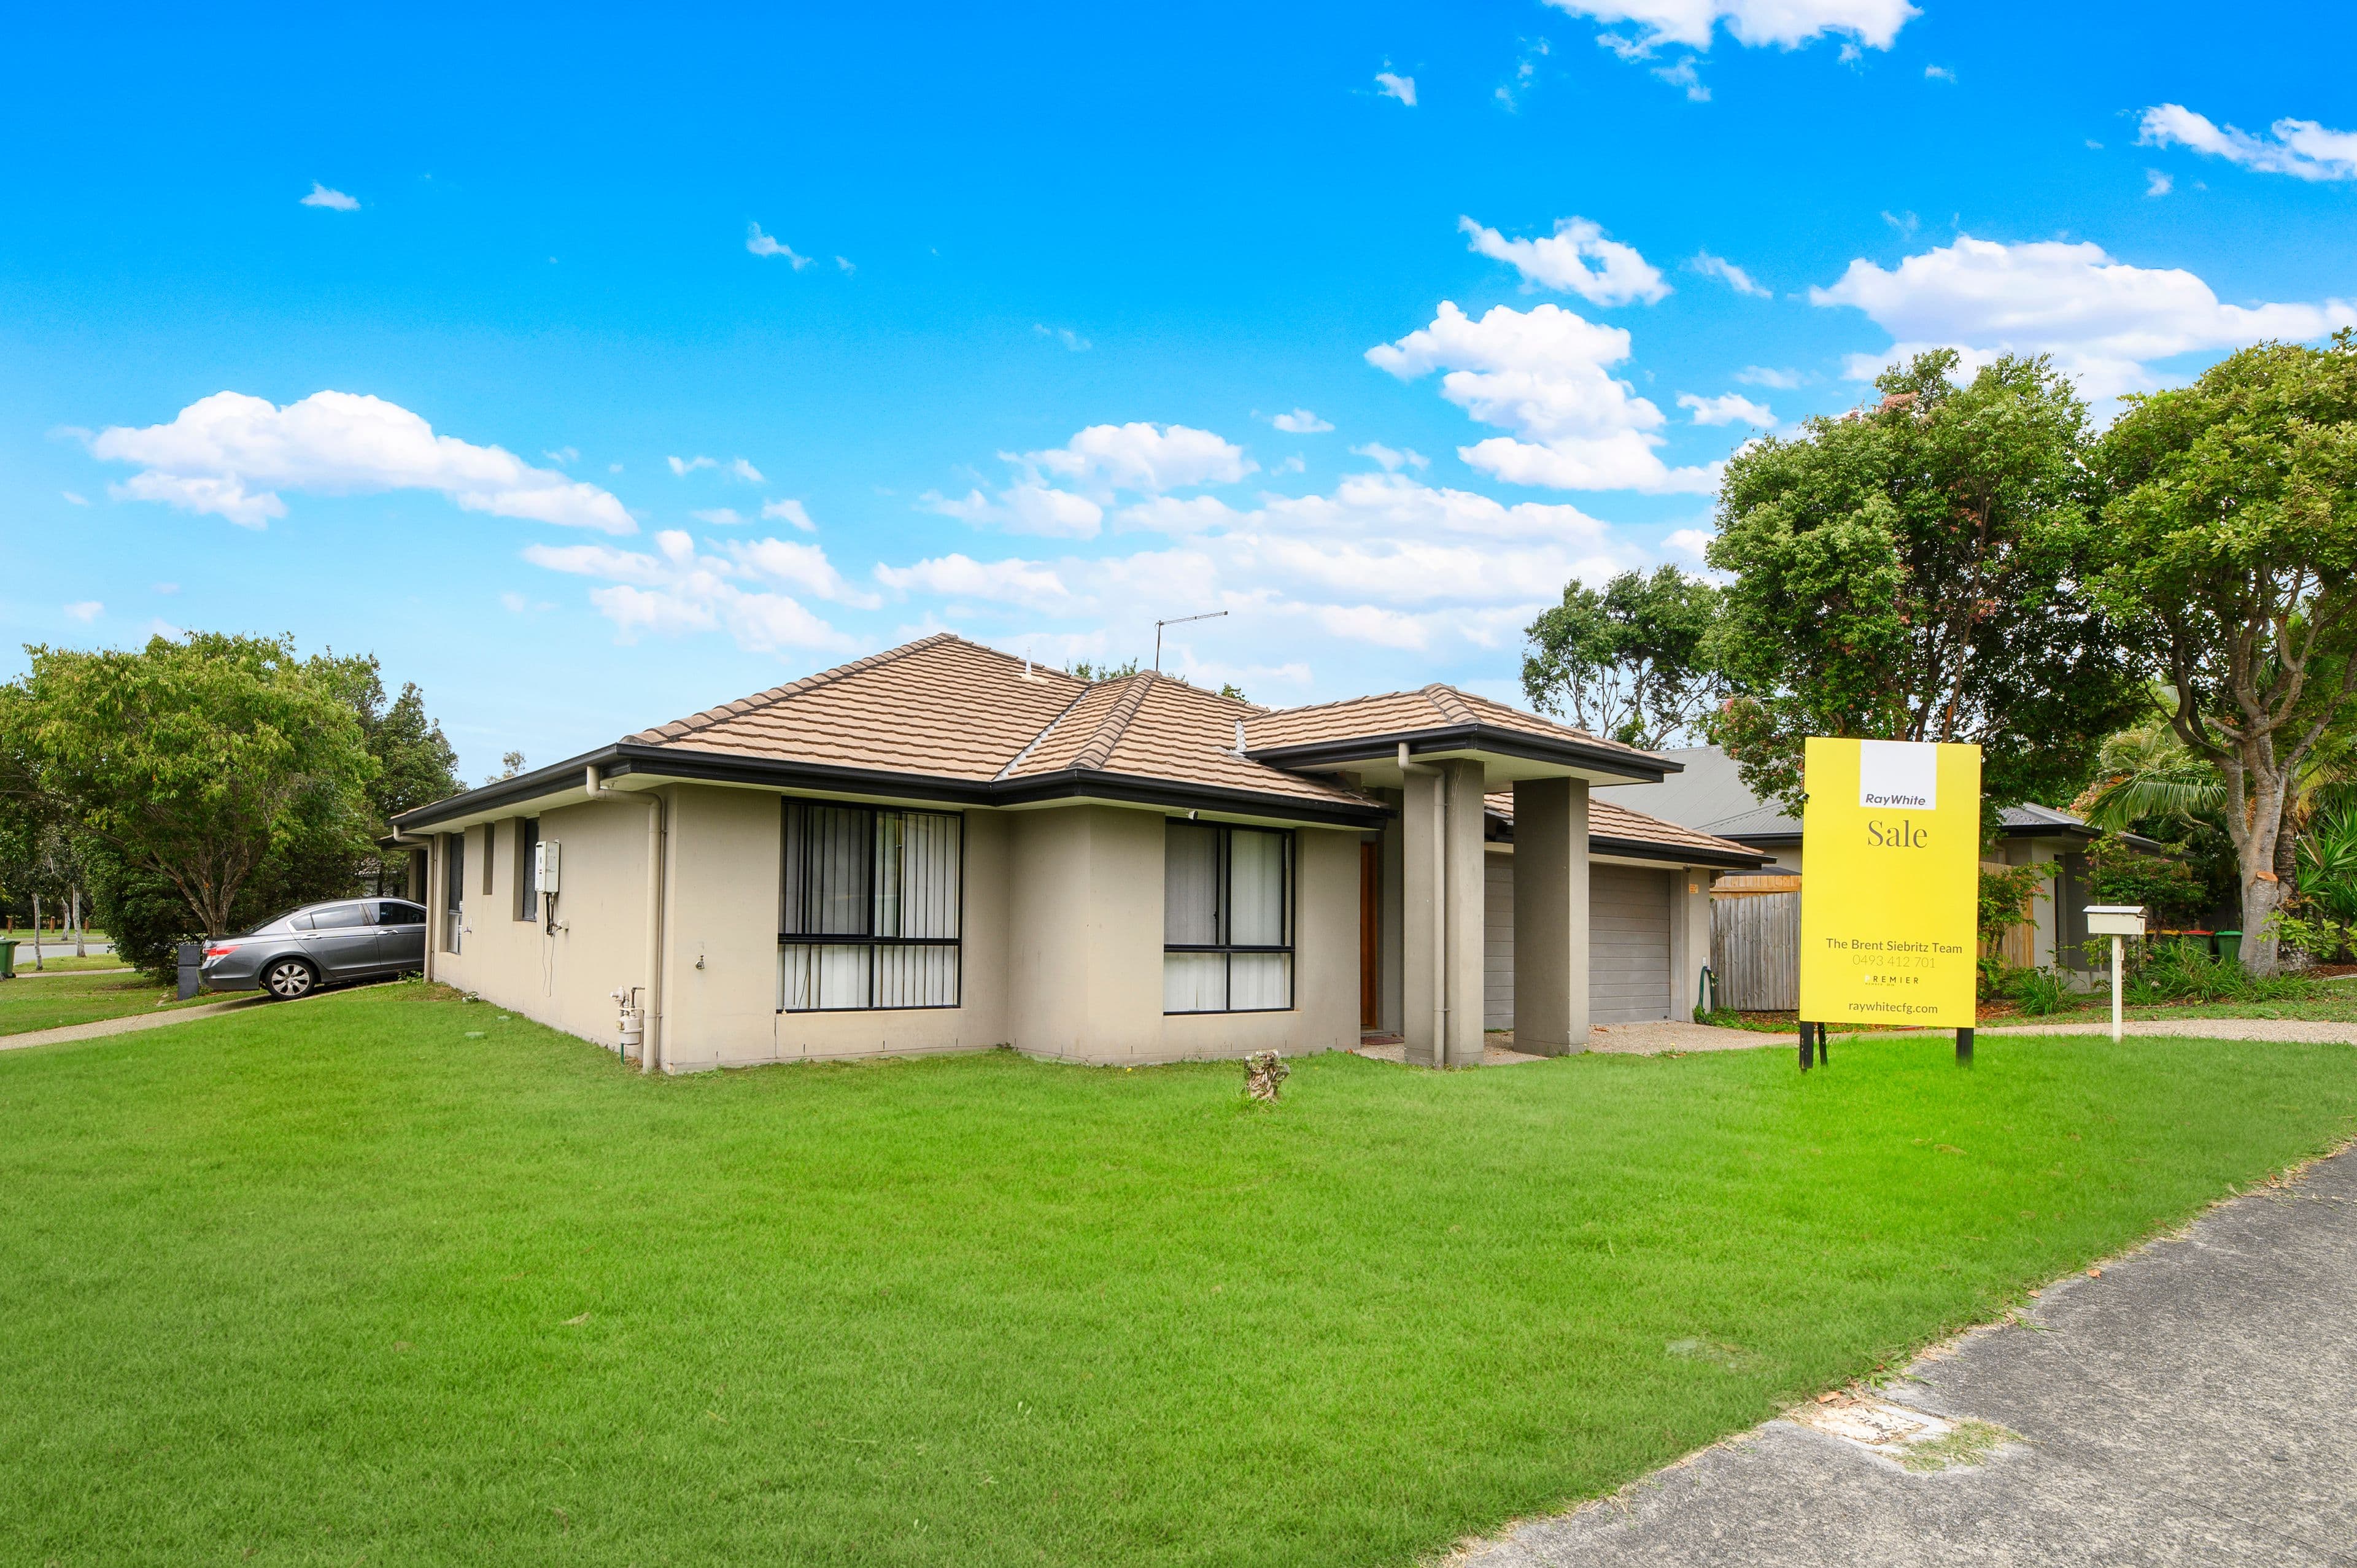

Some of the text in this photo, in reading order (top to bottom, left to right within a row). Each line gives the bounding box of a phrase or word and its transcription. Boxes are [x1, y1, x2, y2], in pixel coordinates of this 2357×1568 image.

[1868, 820, 1927, 848] Sale
[1826, 938, 1962, 954] The Brent Siebritz Team
[1852, 954, 1935, 968] 0493 412 701
[1865, 975, 1919, 984] PREMIER
[1849, 1002, 1938, 1015] raywhitecfg.com
